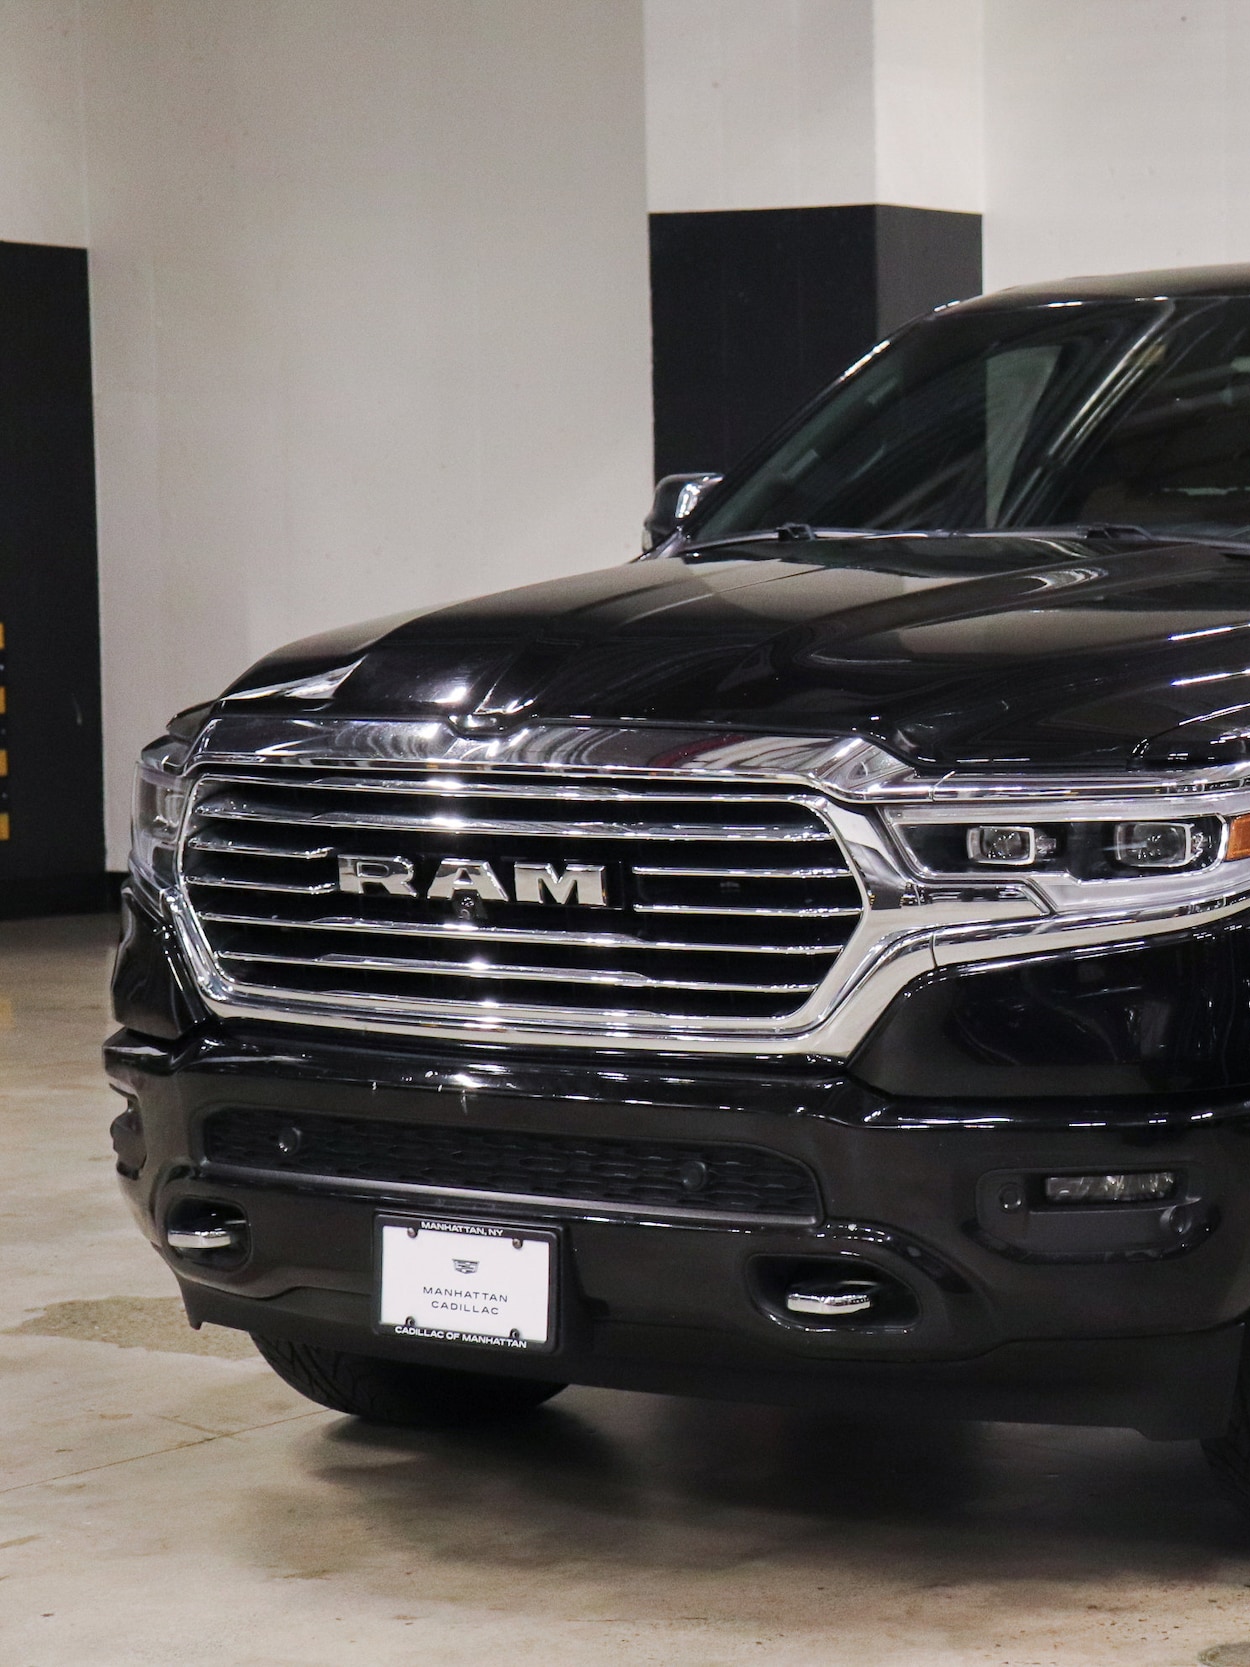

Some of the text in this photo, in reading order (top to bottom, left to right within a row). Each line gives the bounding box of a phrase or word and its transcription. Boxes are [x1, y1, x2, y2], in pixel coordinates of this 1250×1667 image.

[337, 853, 607, 907] RAM
[421, 1221, 503, 1237] MANHATTAN, NY
[423, 1286, 508, 1303] MANHATTAN
[431, 1300, 499, 1315] CADILLAC
[395, 1326, 445, 1339] CADILLAC
[462, 1334, 527, 1349] MANHATTAN
